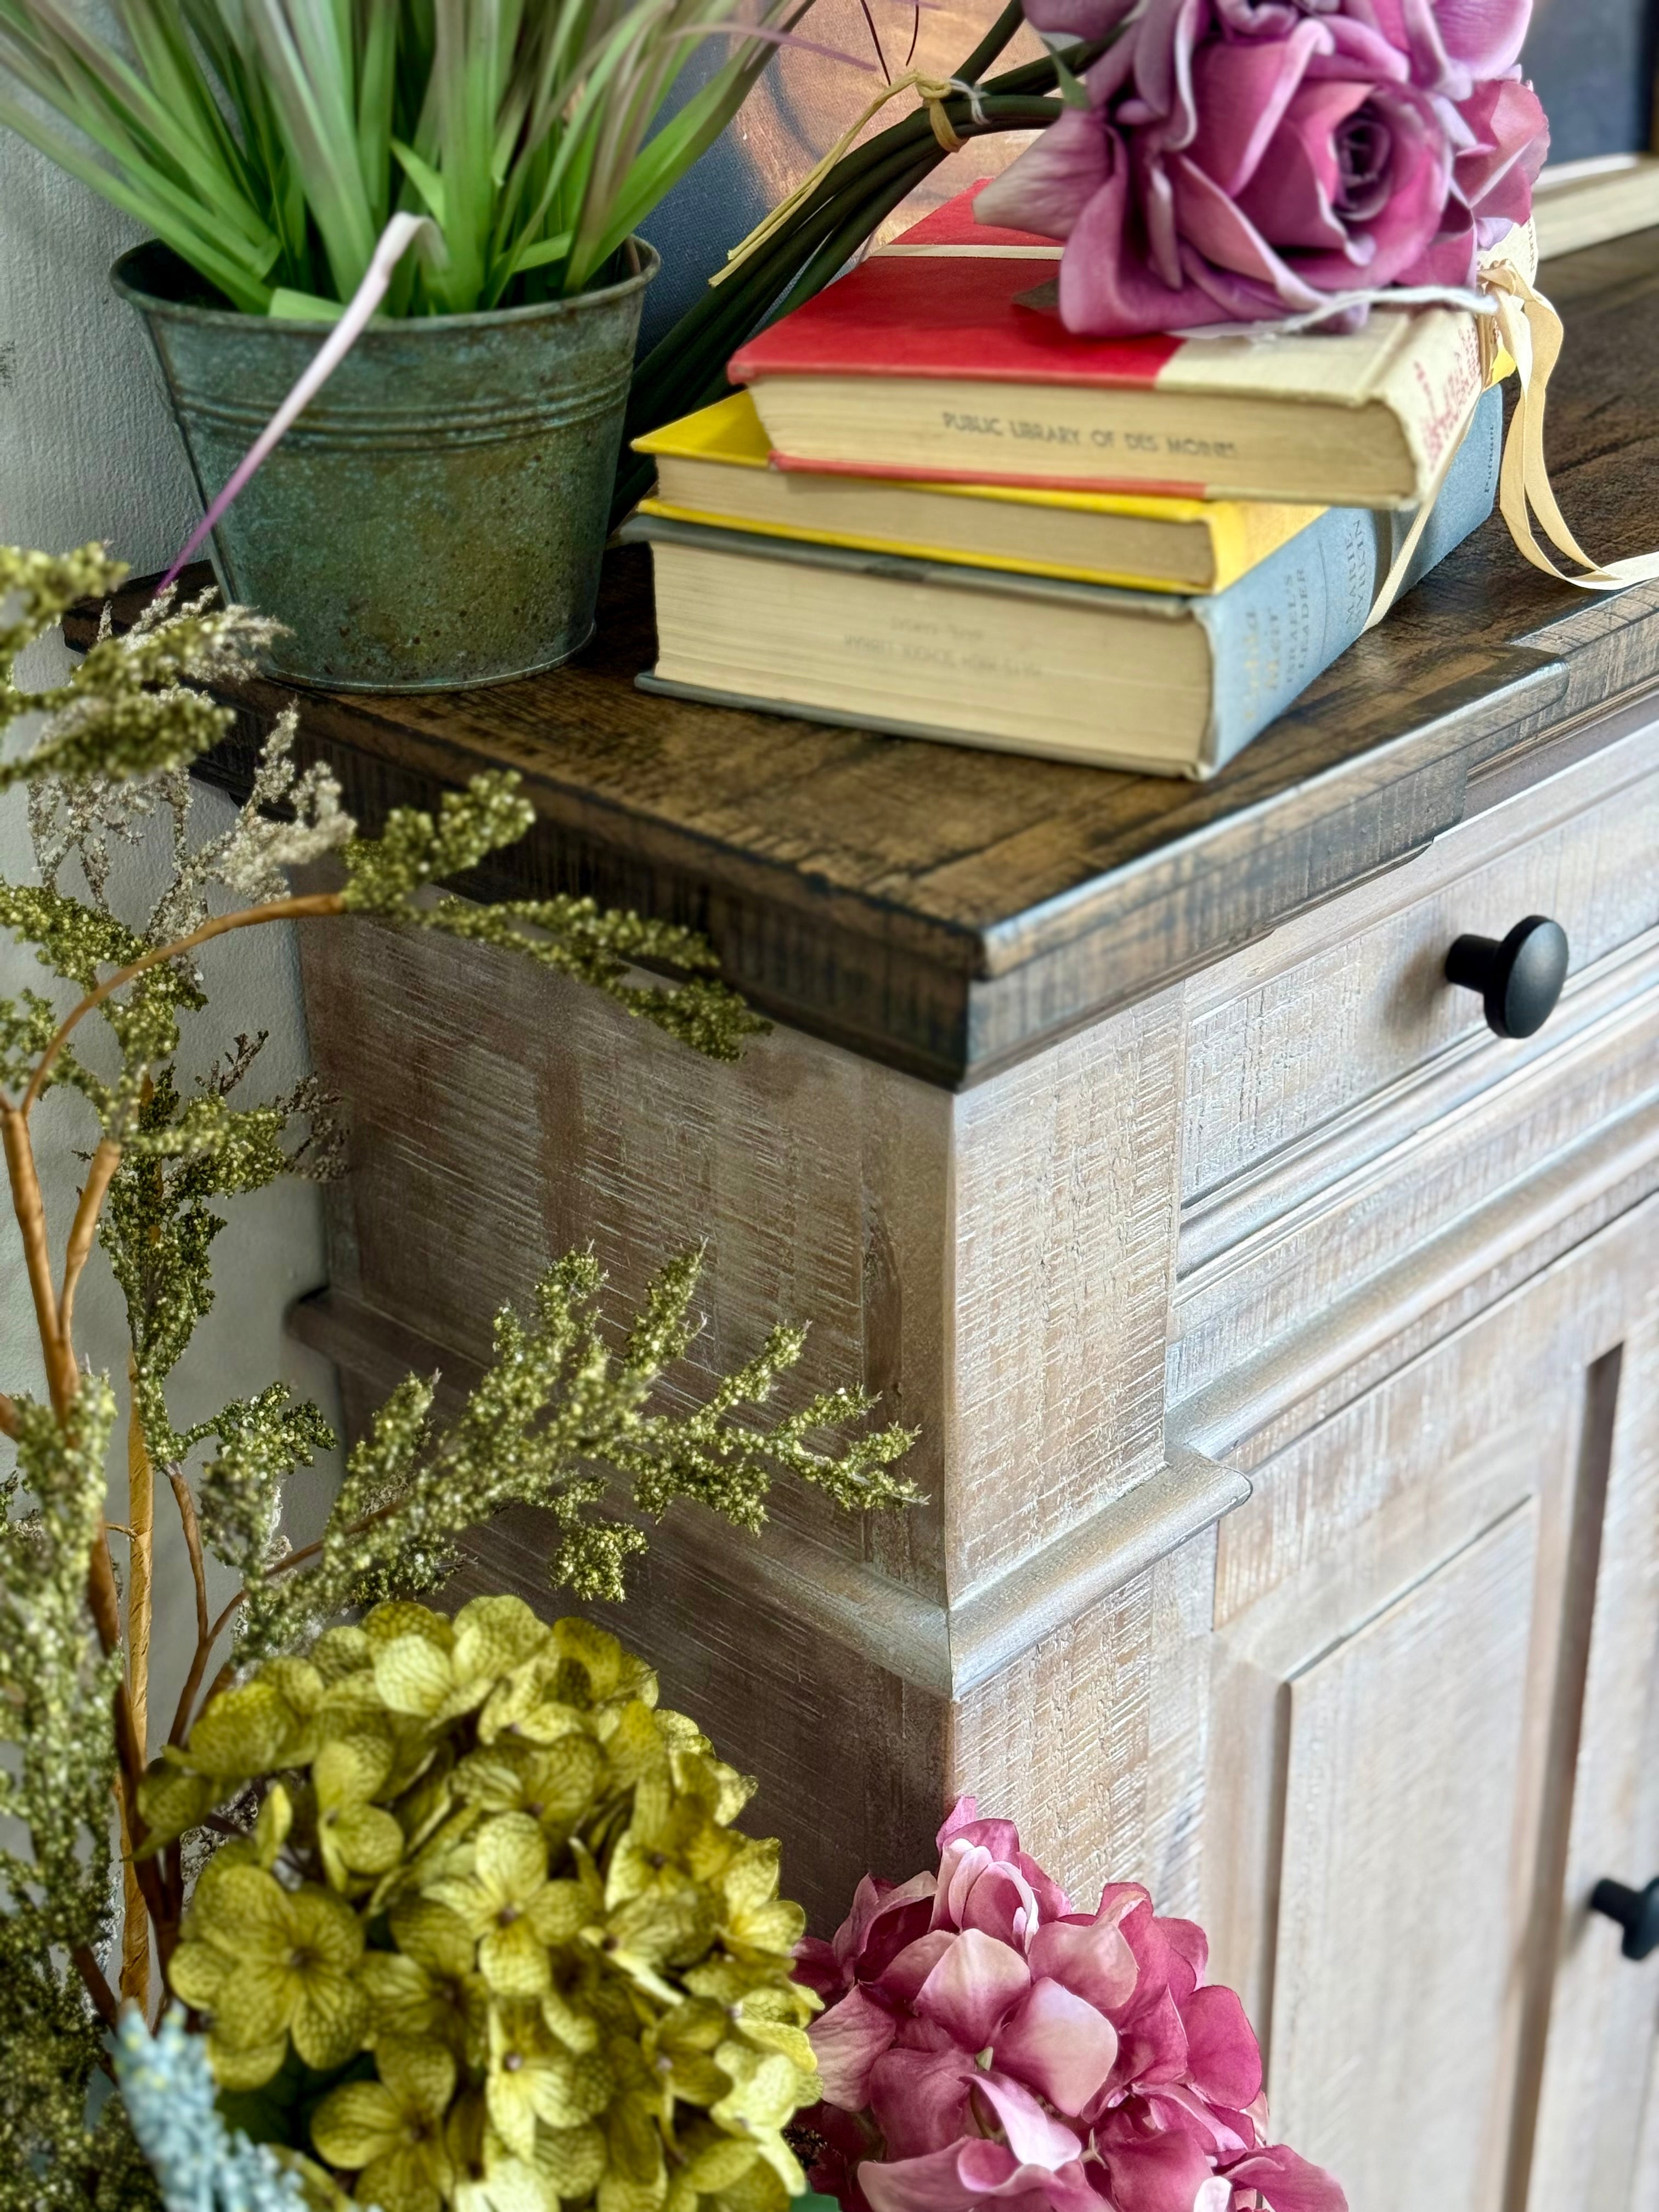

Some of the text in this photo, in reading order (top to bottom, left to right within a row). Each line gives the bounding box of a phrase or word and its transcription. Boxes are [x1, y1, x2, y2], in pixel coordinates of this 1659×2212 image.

[943, 412, 1003, 436] PUBLIC
[1009, 420, 1080, 444] LIBRARY
[1090, 430, 1115, 448] OF
[1124, 433, 1159, 452] DES
[1297, 568, 1309, 669] LEADER
[1345, 533, 1357, 624] MARIE
[1353, 520, 1366, 623] SYRKIN
[1284, 575, 1297, 683] ISRAEL'S
